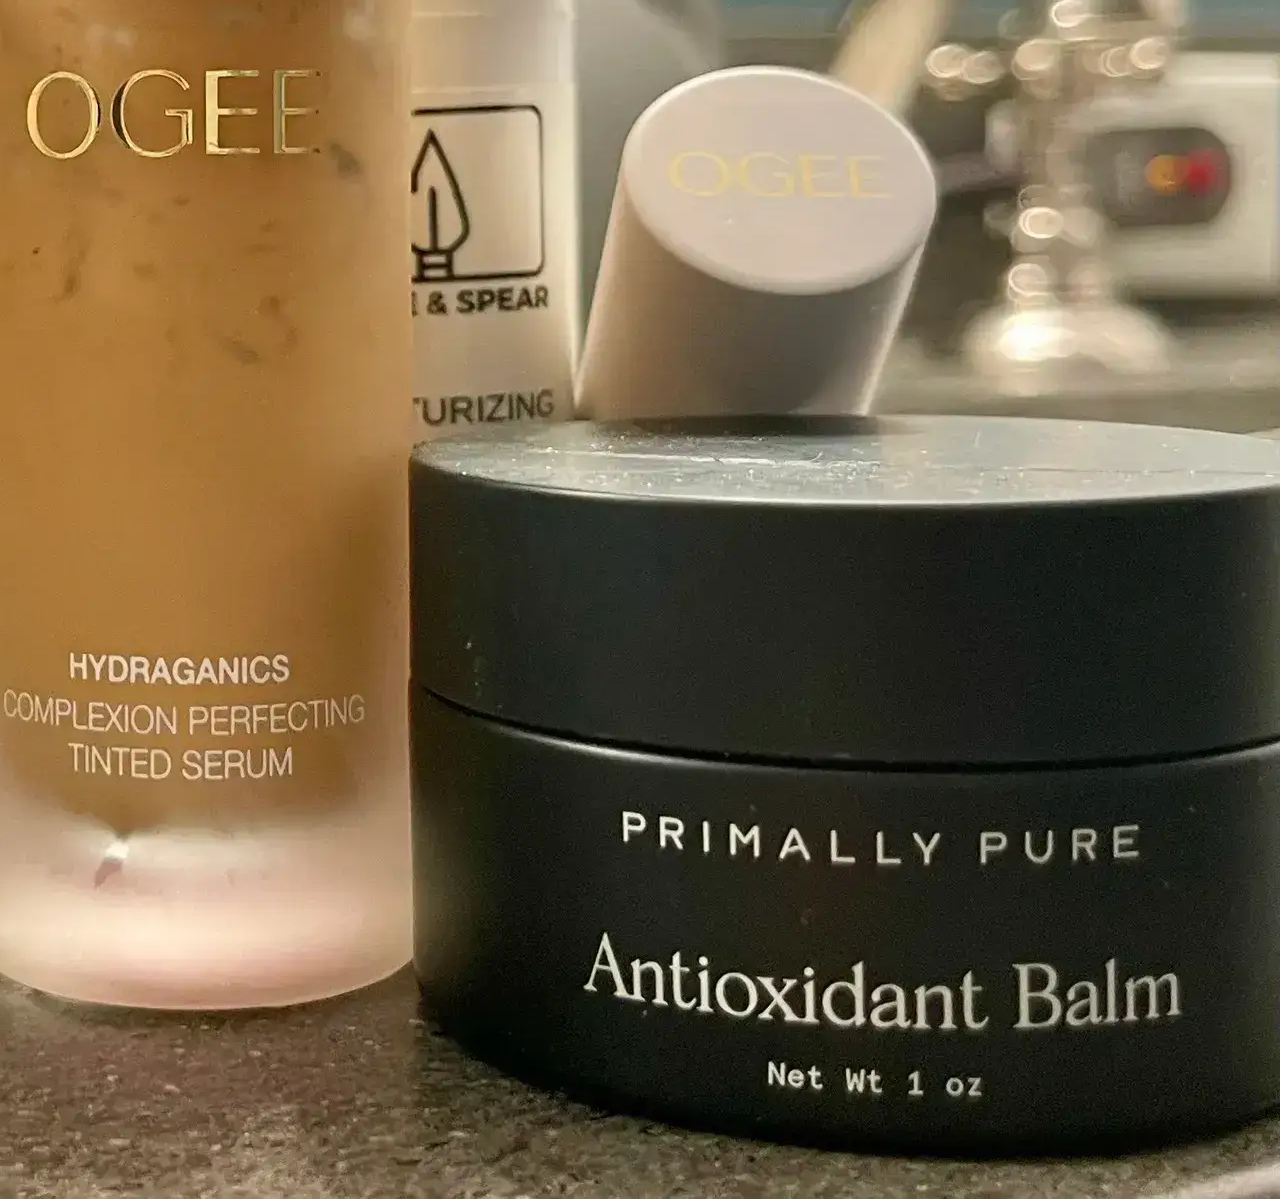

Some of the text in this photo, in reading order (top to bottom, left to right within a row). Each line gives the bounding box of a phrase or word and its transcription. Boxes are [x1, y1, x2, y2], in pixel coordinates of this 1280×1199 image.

[26, 69, 321, 159] OGEE
[669, 150, 893, 198] OGEE
[426, 291, 448, 315] &
[455, 285, 549, 314] SPEAR
[412, 389, 554, 427] URIZING
[69, 652, 290, 685] HYDRAGANICS
[3, 688, 365, 736] COMPLEXION PERFECTING
[68, 742, 293, 780] TINTED SERUM
[622, 811, 1143, 865] PRIMALLY PURE
[583, 931, 1183, 1031] Antioxidant Balm
[767, 1061, 984, 1097] Net Wt 1 oz
